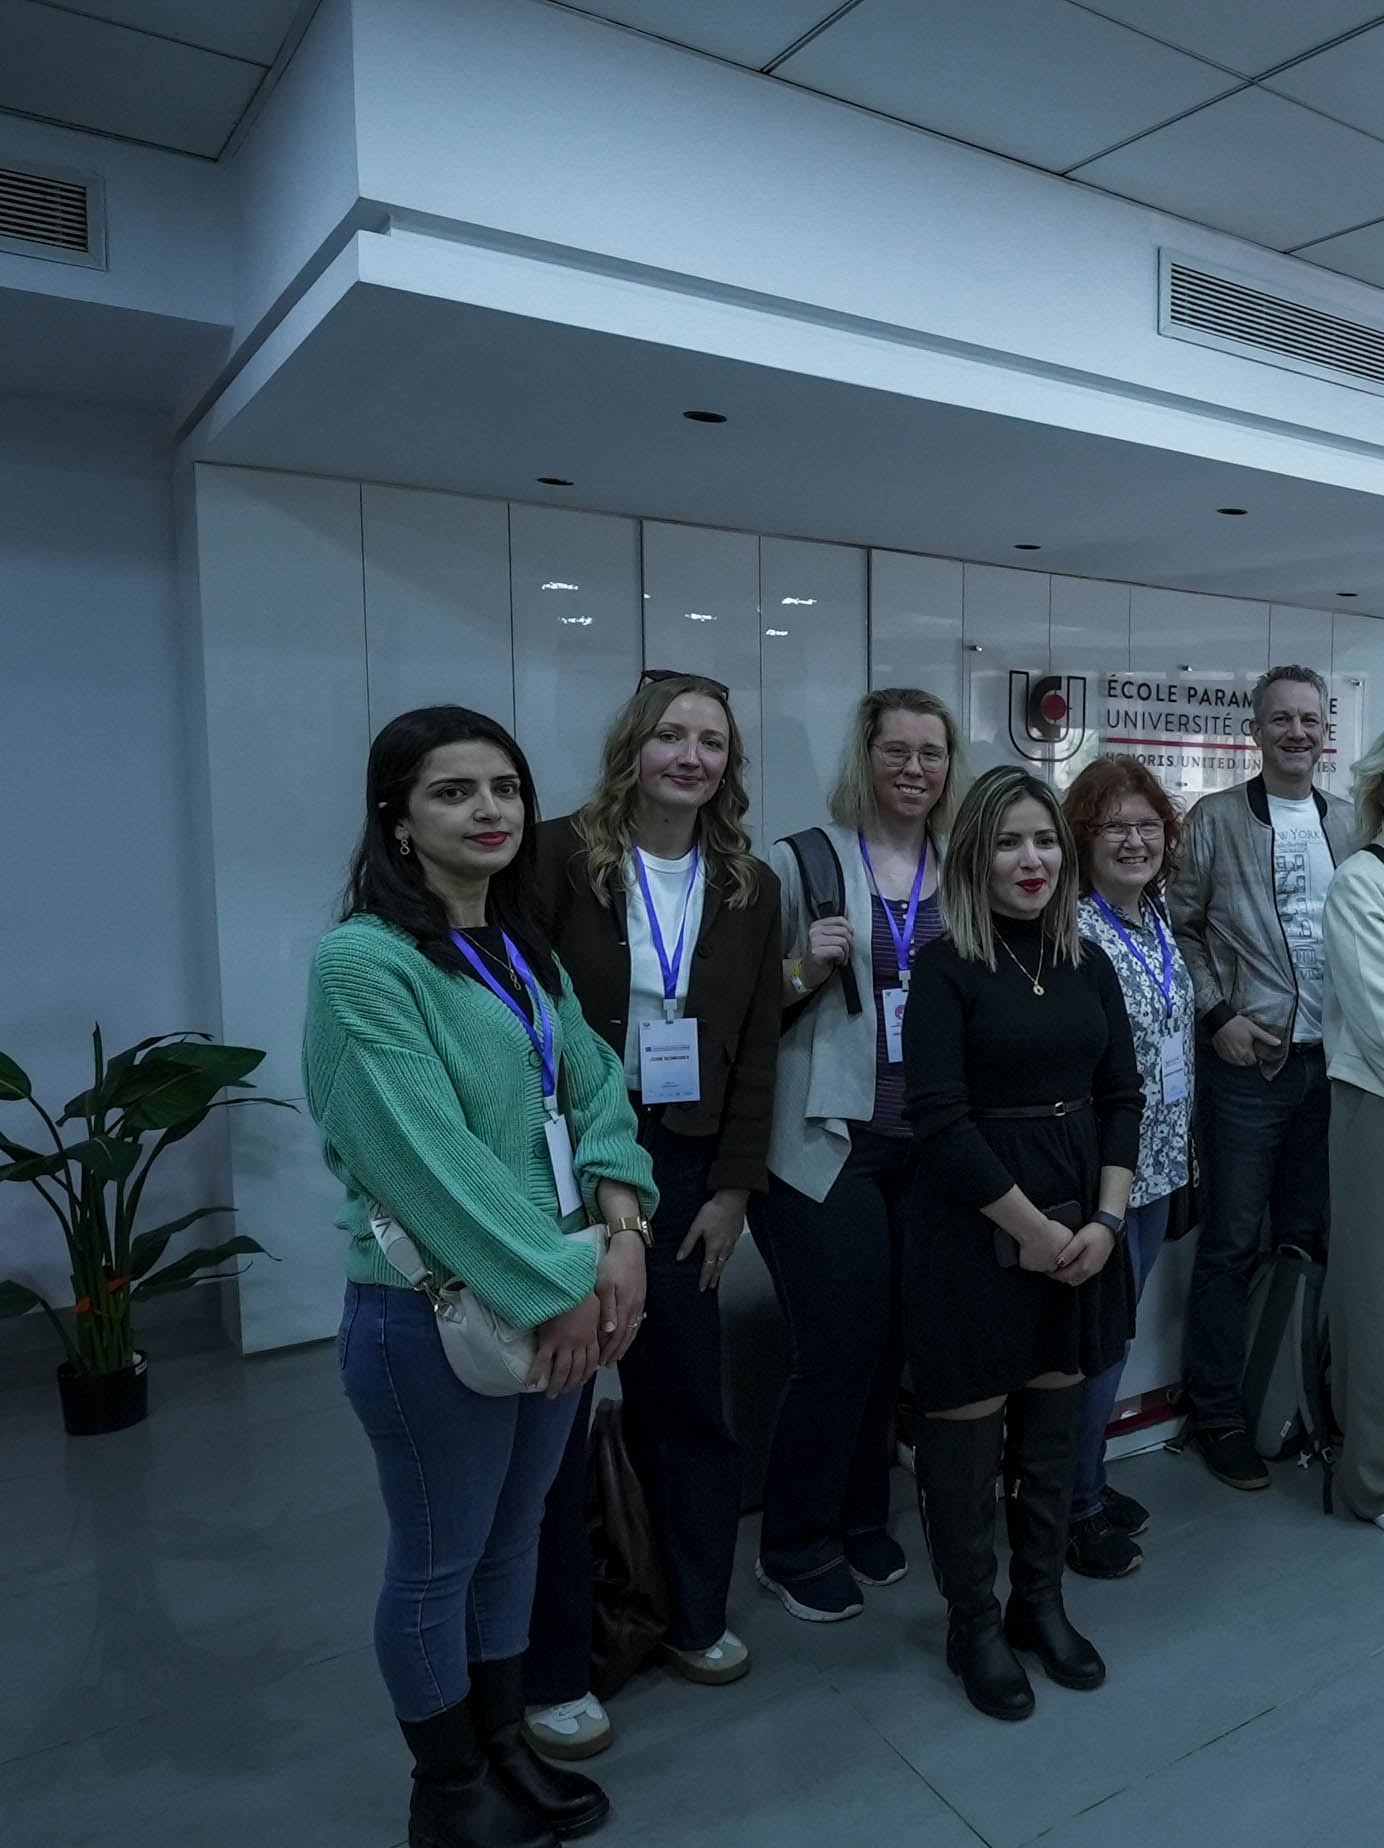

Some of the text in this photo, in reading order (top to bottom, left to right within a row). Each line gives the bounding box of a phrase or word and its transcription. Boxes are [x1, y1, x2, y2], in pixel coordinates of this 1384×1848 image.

[1107, 674, 1178, 702] ÉCOLE
[1107, 709, 1233, 736] UNIVERSITÉ
[1105, 751, 1174, 768] HORIS
[1181, 755, 1236, 769] UNITED
